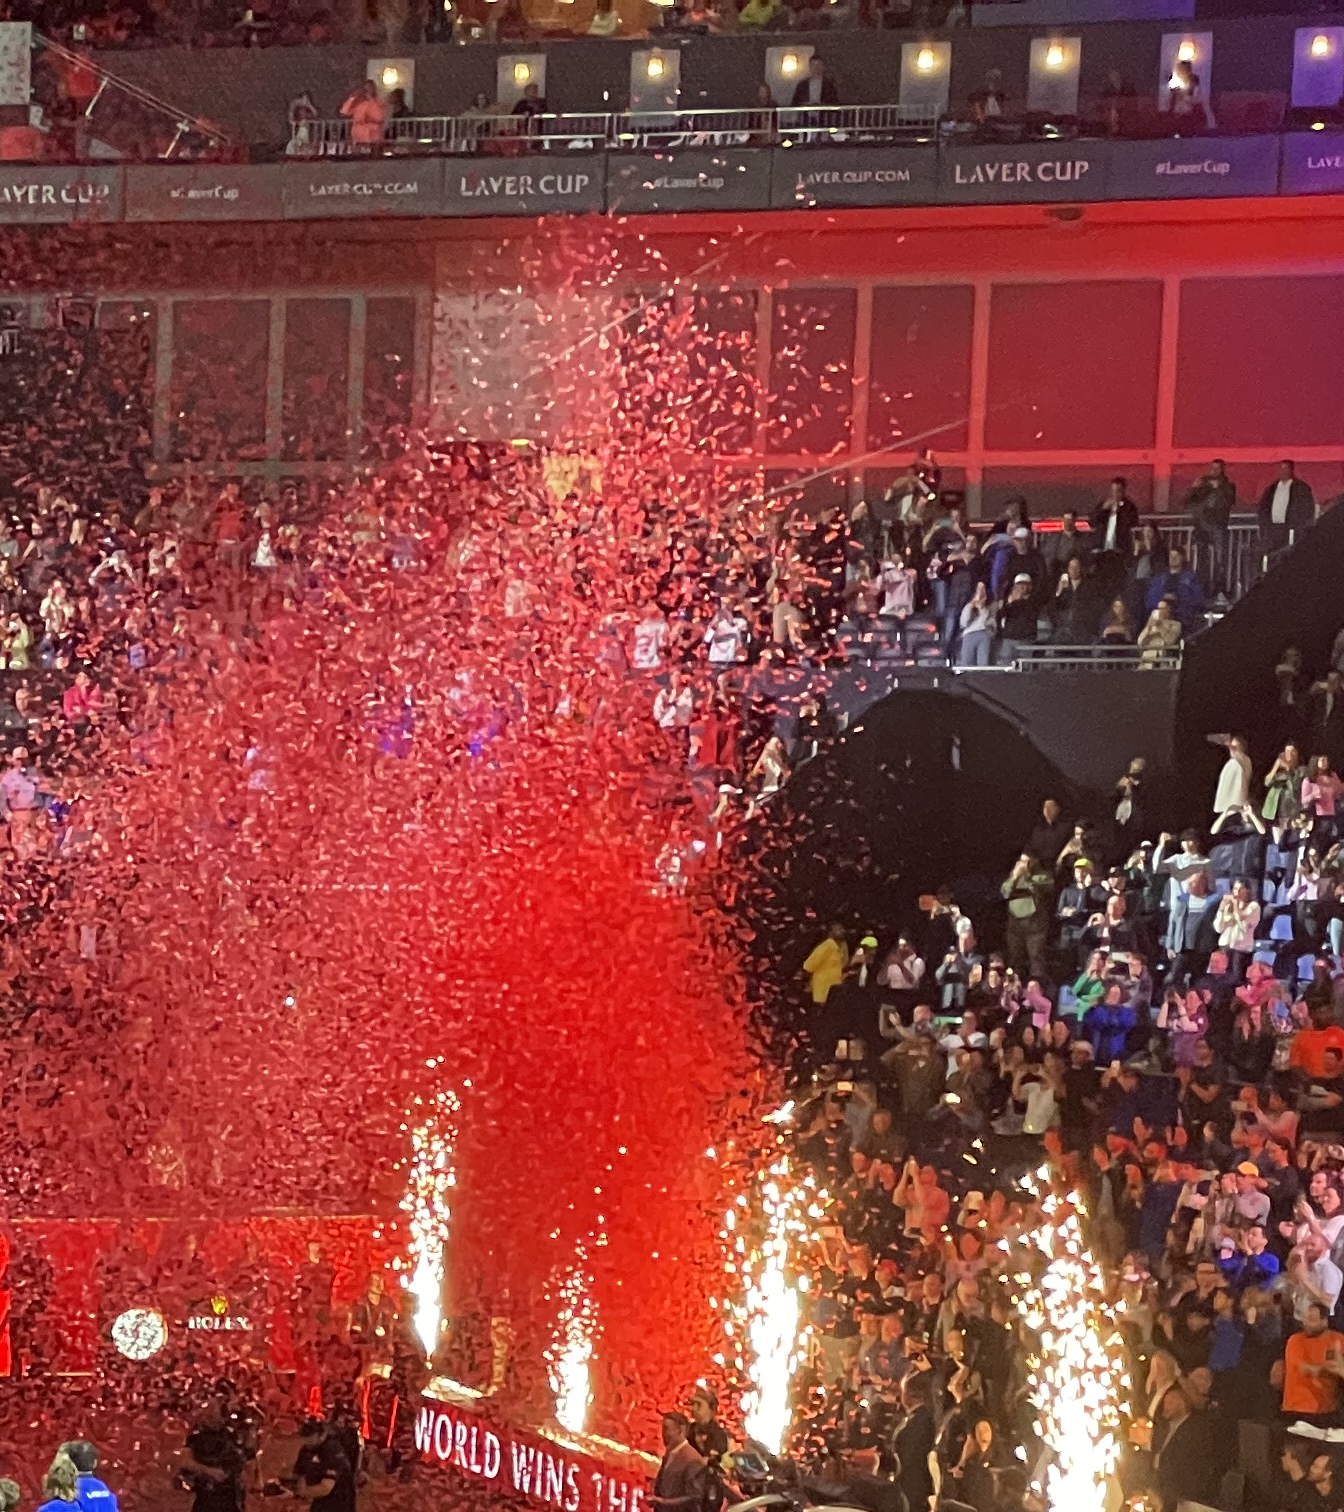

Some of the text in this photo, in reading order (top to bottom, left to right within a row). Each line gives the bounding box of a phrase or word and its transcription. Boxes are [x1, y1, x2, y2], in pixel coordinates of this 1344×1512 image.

[955, 160, 1089, 184] LAVER CUP
[1155, 160, 1231, 176] #LaverCup
[461, 174, 590, 197] LAVER CUP
[414, 1405, 502, 1479] WORLD
[511, 1441, 580, 1512] WINS
